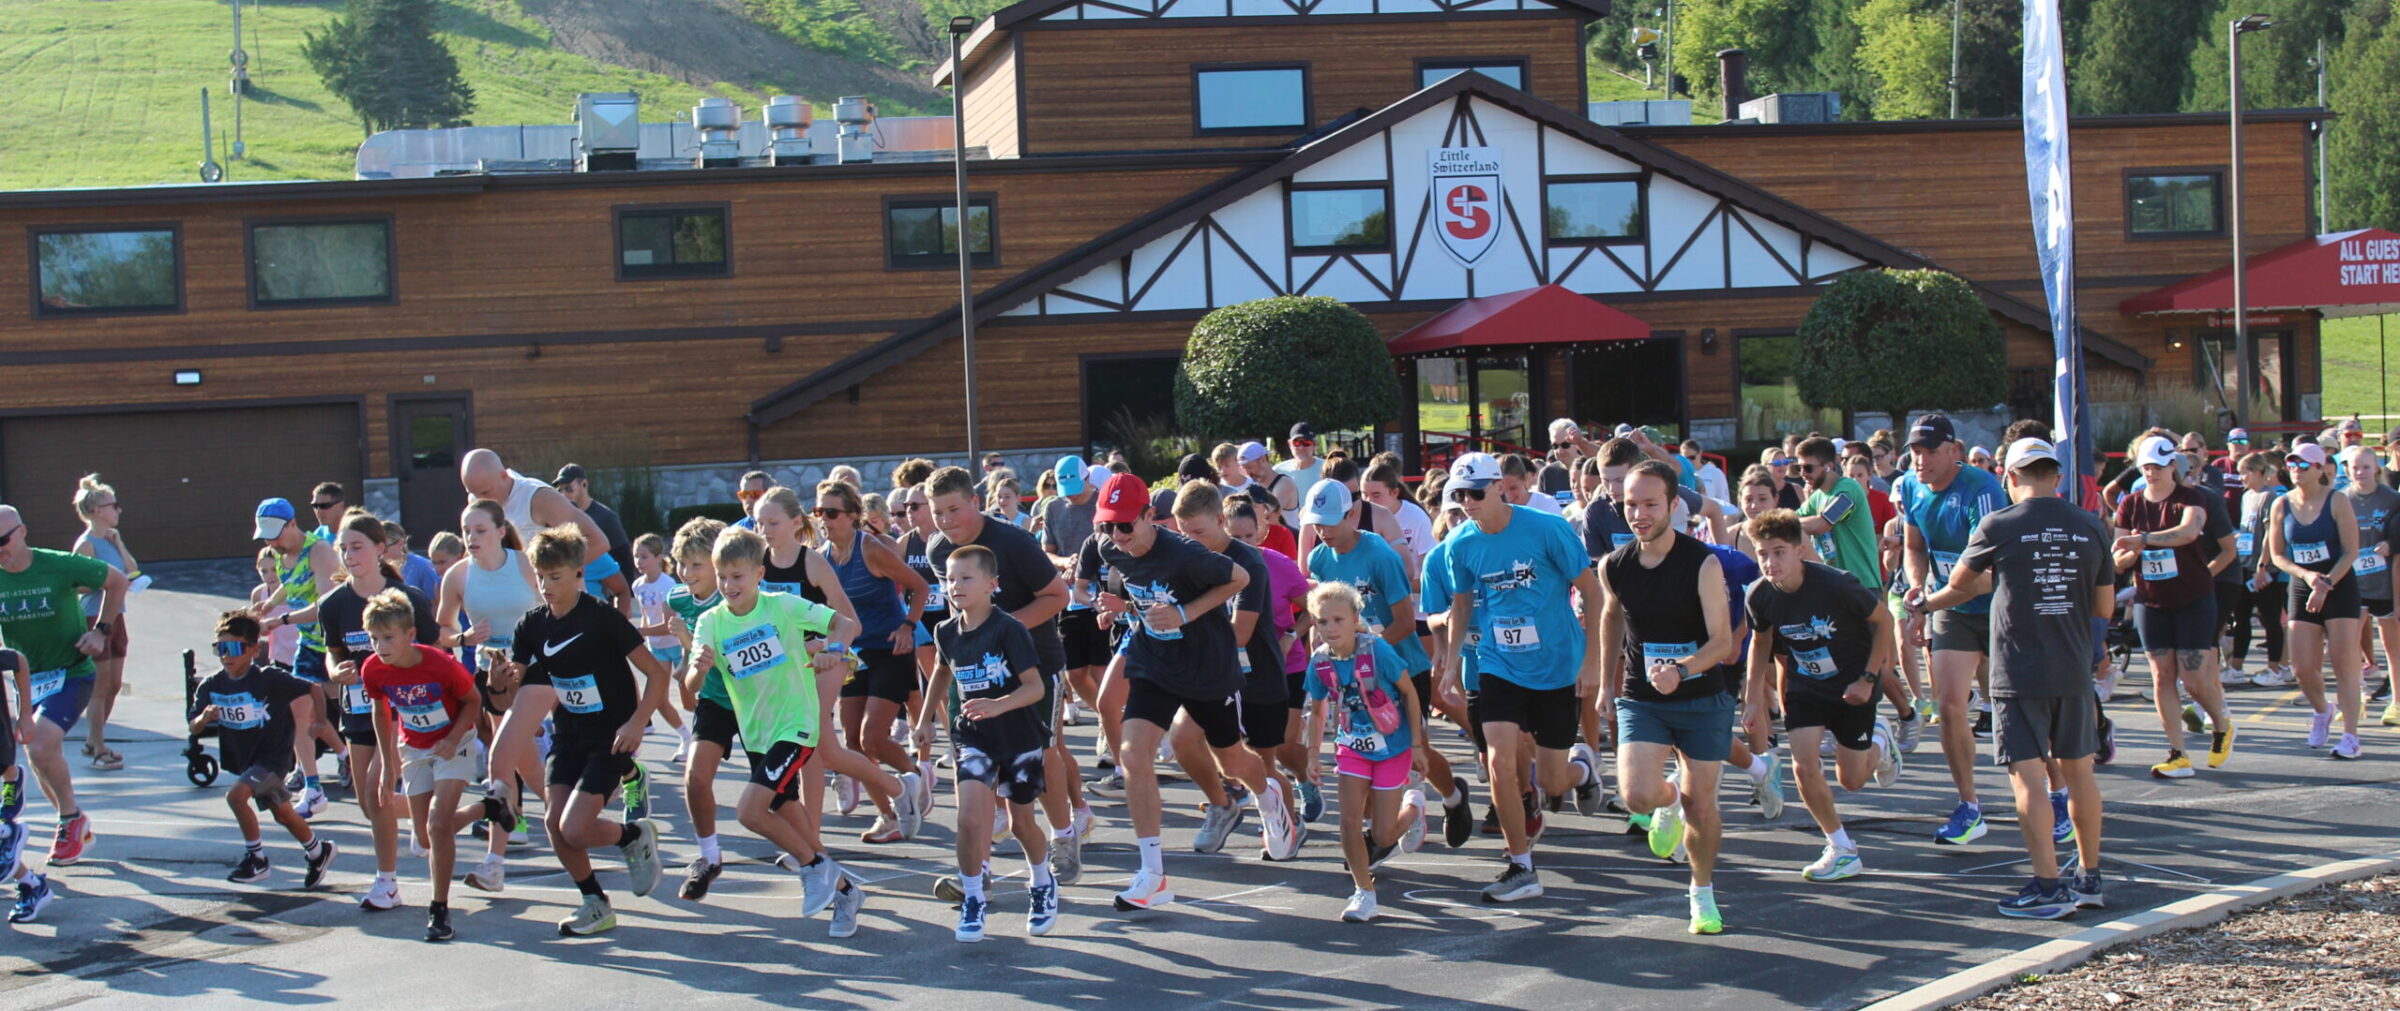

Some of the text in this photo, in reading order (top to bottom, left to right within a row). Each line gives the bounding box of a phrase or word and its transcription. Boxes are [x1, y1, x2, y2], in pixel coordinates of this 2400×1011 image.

[1440, 150, 1470, 161] Little
[1433, 161, 1499, 173] Switzerland
[2340, 240, 2363, 261] ALL
[2340, 263, 2400, 286] START HE
[1109, 489, 1121, 504] S
[2300, 549, 2321, 562] 134
[2150, 561, 2163, 573] 31
[2361, 557, 2375, 569] 29
[1515, 567, 1537, 581] 5K
[1503, 629, 1522, 644] 97
[737, 642, 772, 667] 203
[986, 660, 1012, 679] 5K
[36, 680, 58, 696] 157
[566, 691, 586, 705] 42
[219, 706, 245, 721] 166
[412, 714, 430, 726] 41
